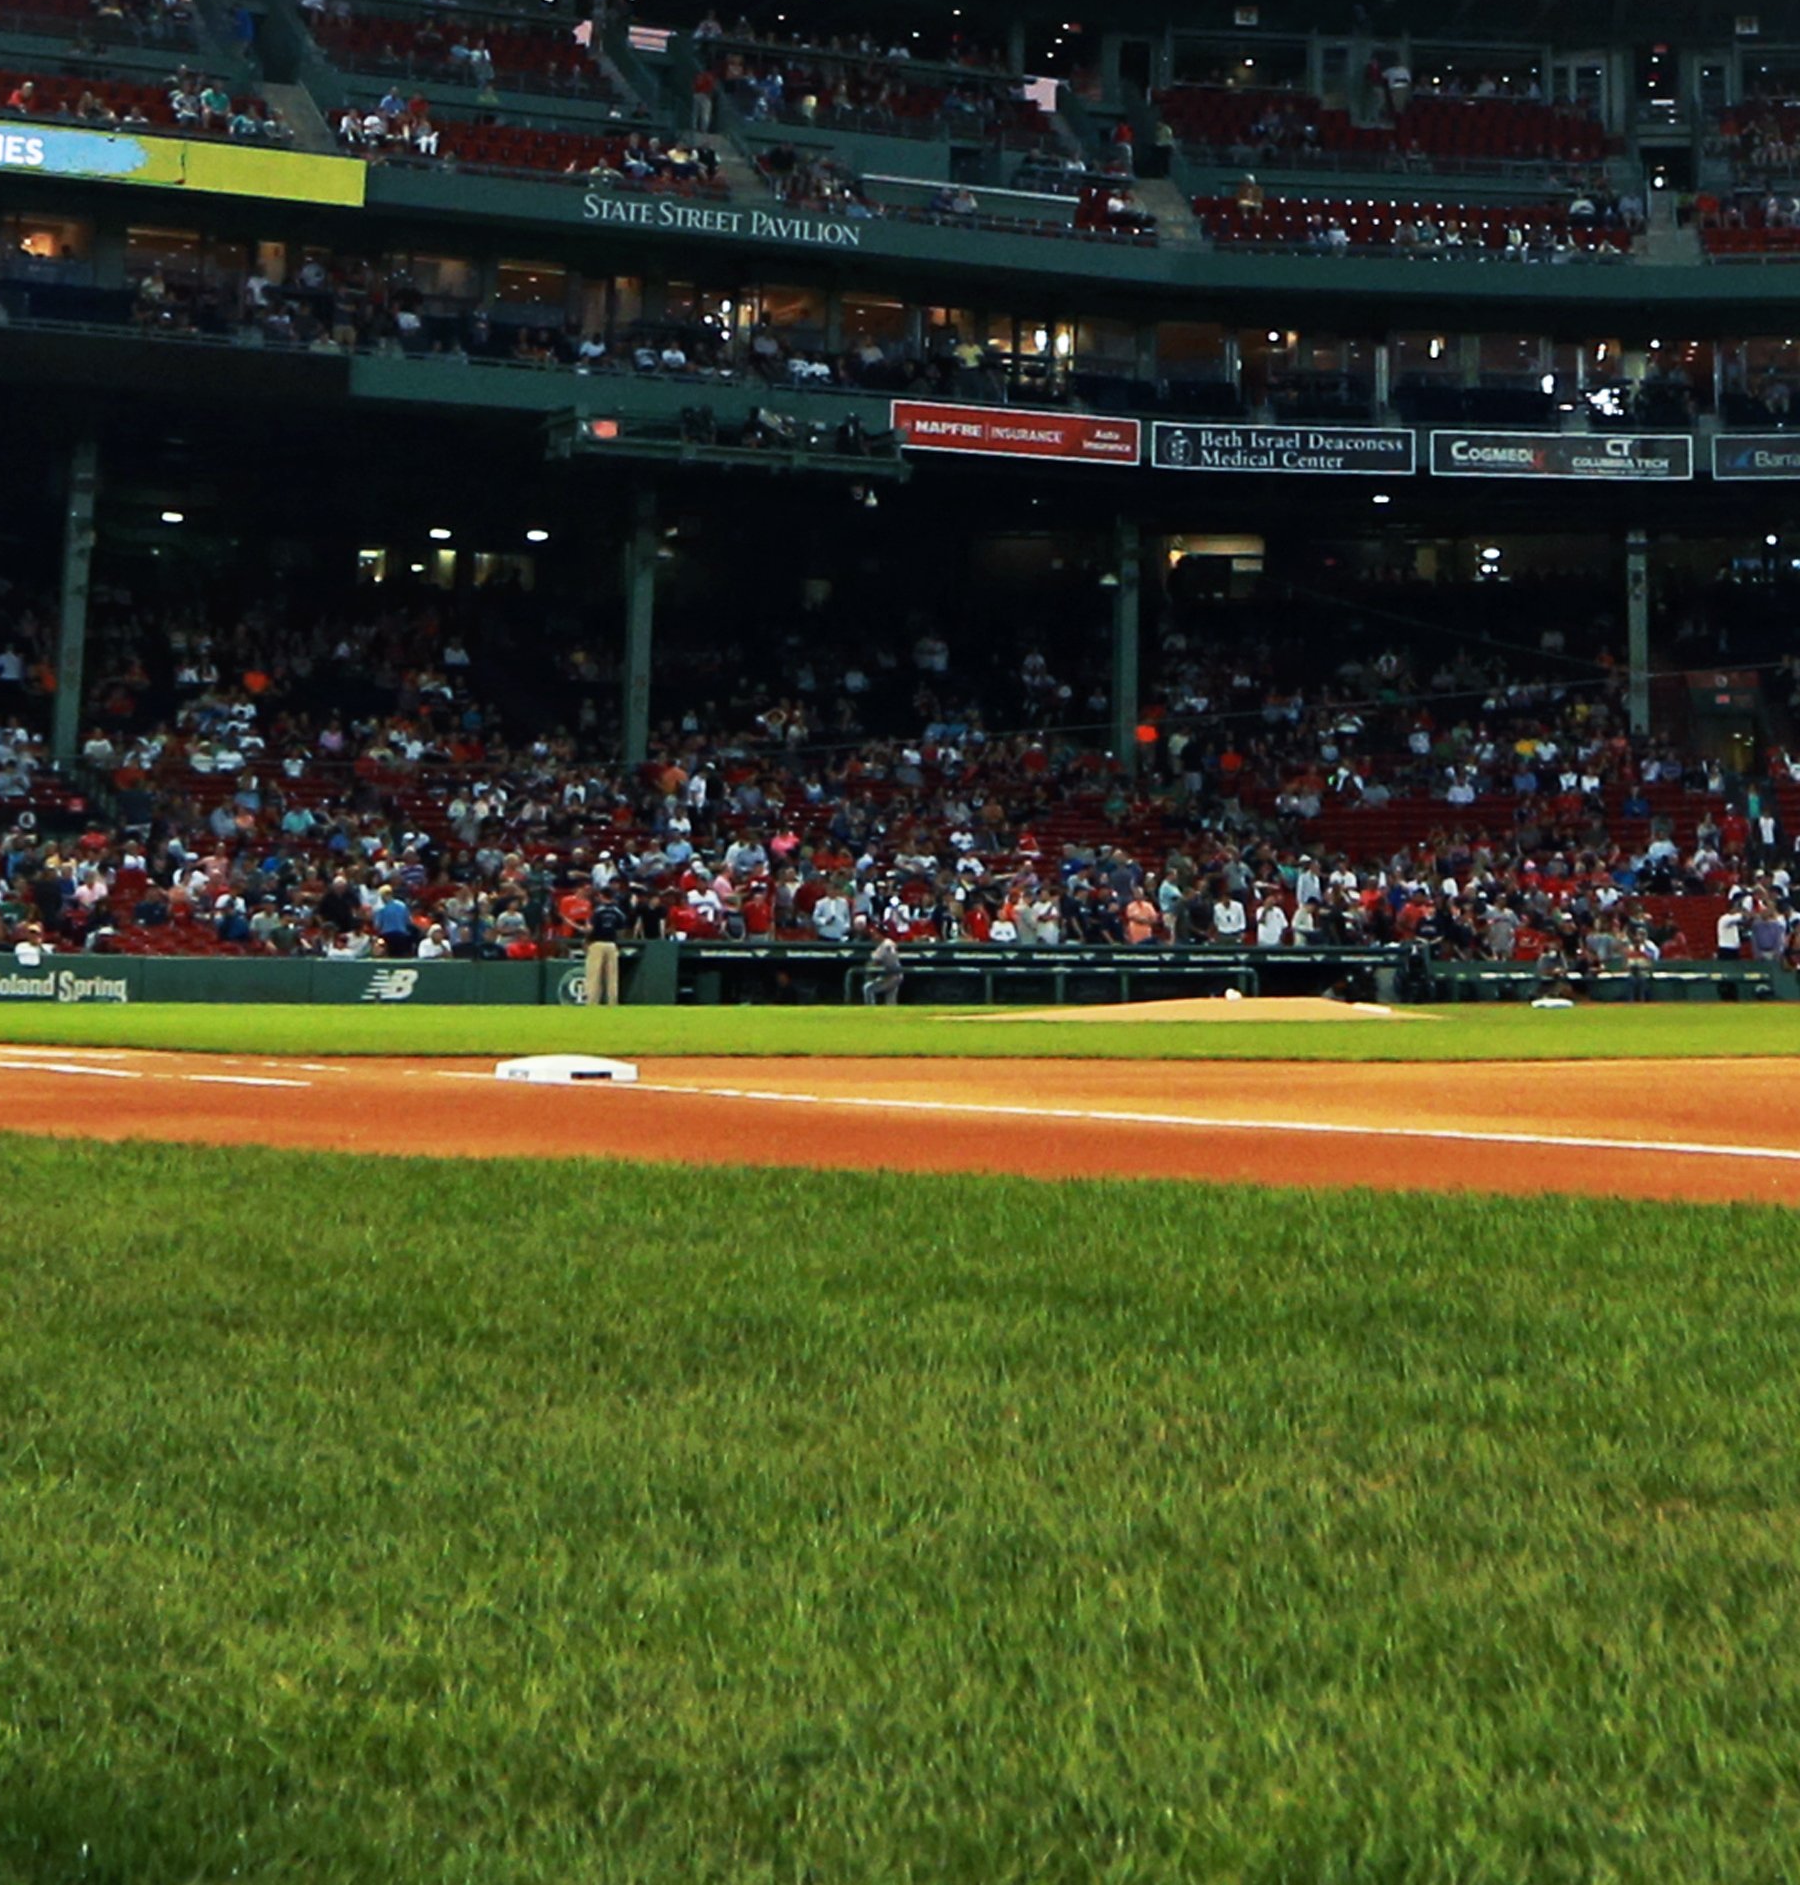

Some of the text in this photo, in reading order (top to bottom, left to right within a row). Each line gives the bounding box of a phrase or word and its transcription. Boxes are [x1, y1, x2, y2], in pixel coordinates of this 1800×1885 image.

[583, 193, 860, 245] STATE STREET PAVILION
[916, 420, 1064, 443] MAPFRE INSURANCE
[1200, 431, 1403, 450] Beth Israel Deaconess
[1200, 450, 1344, 468] Medical Center
[58, 970, 127, 1002] Spring
